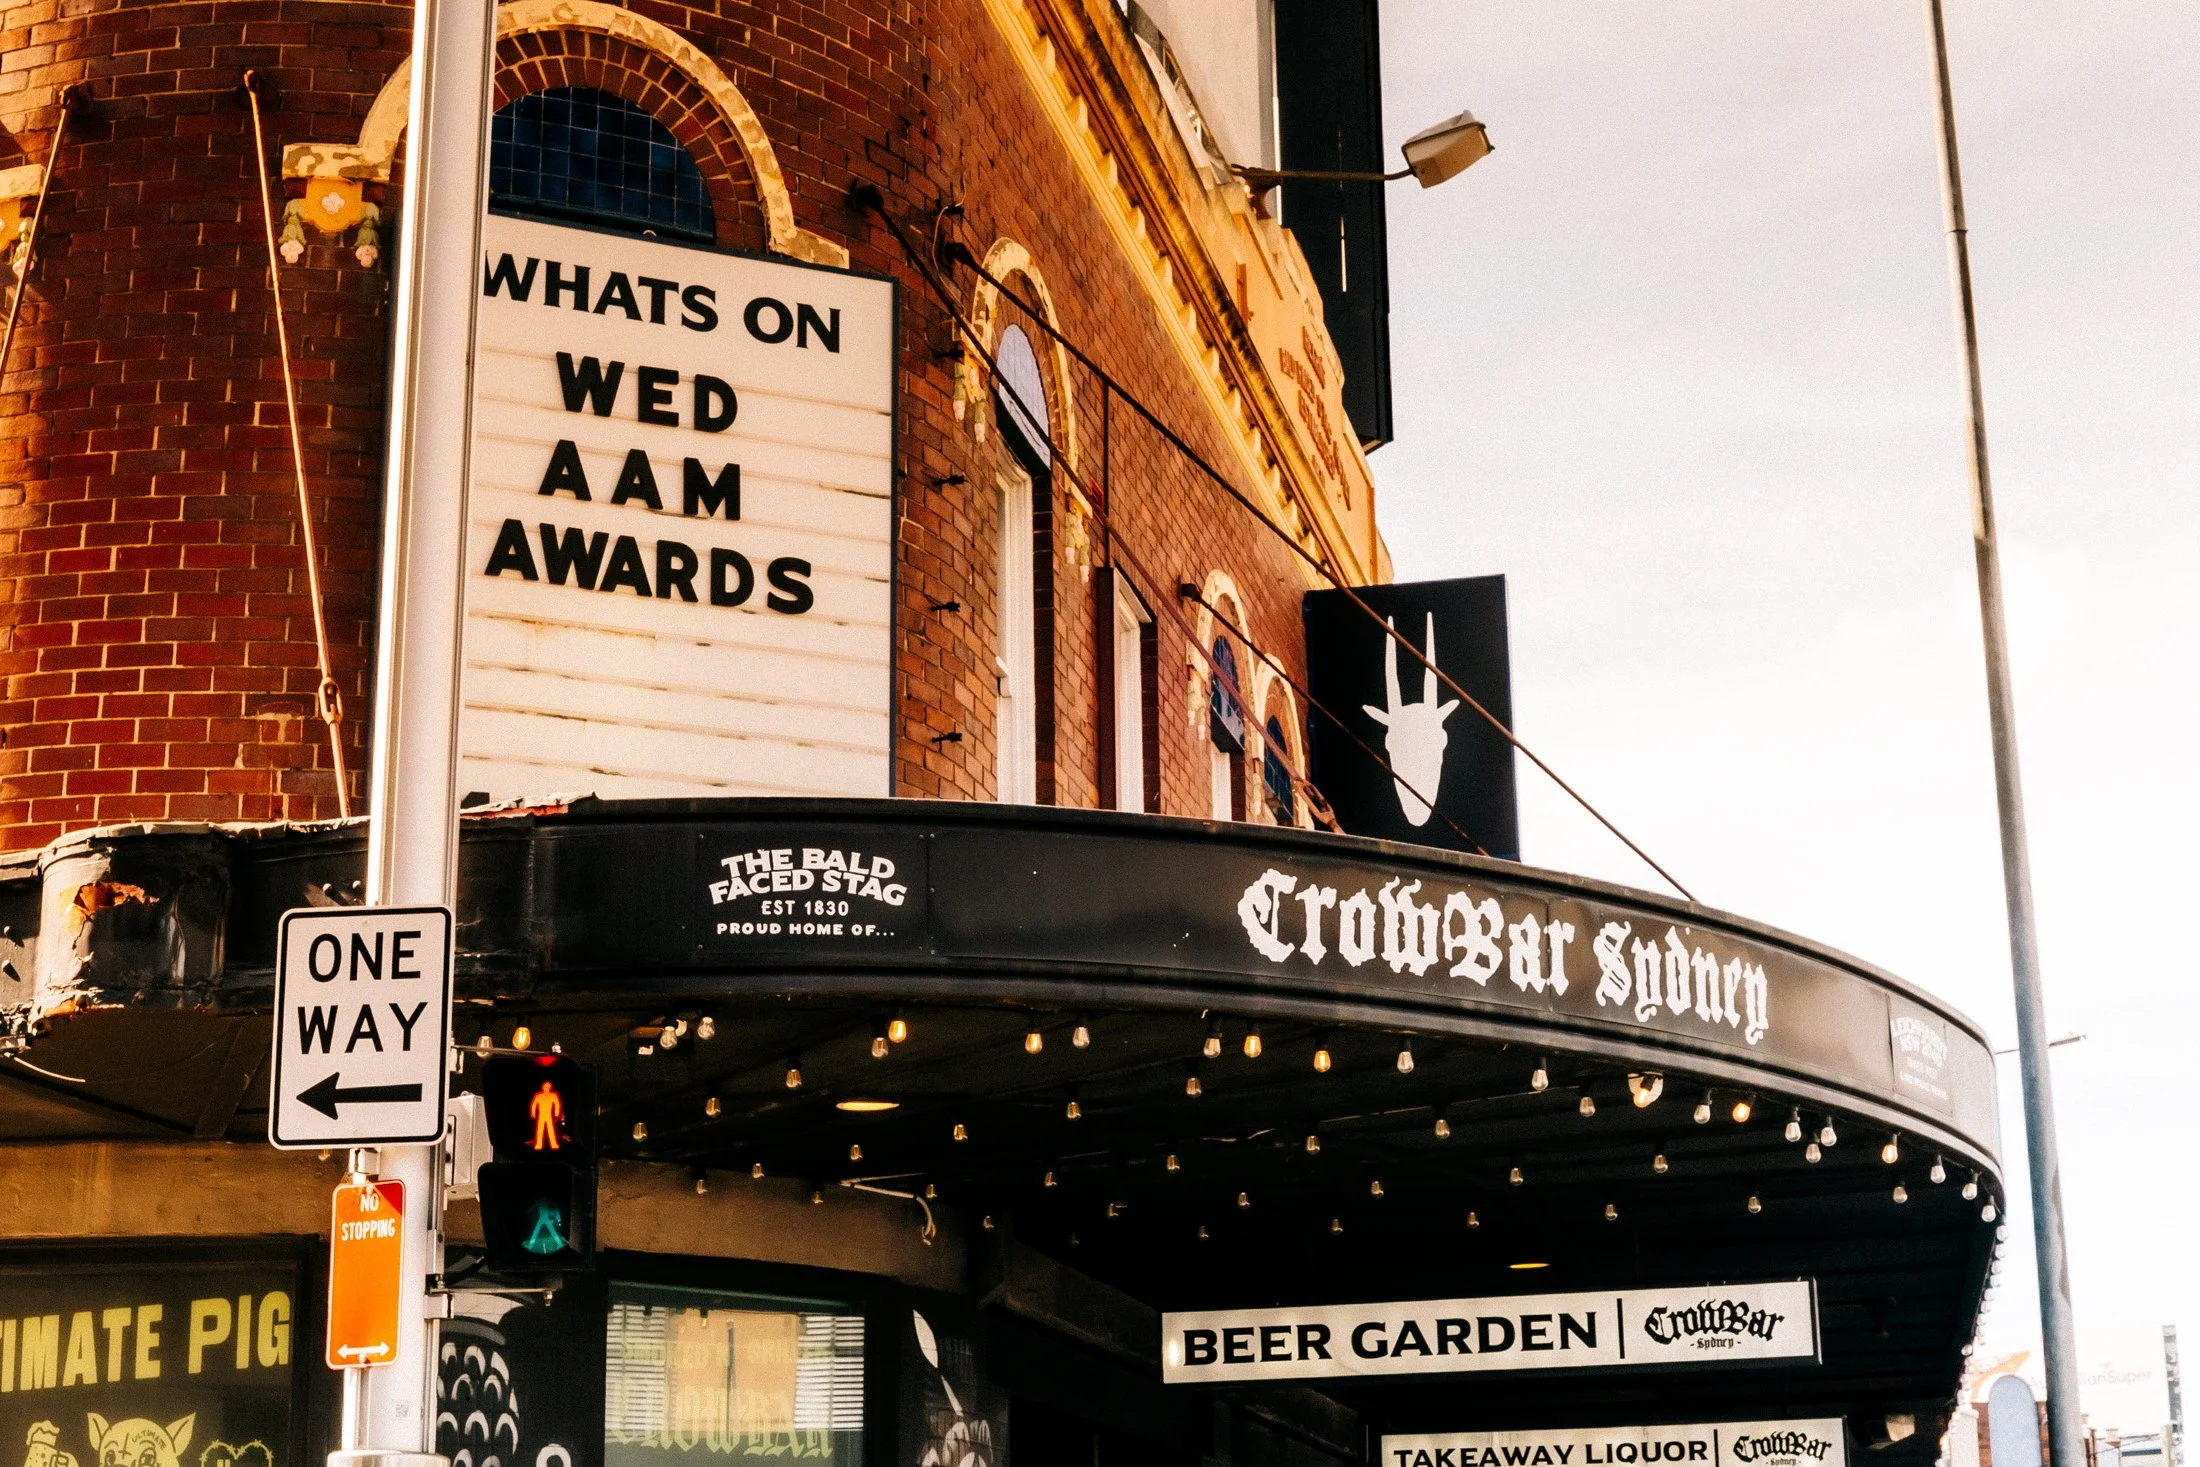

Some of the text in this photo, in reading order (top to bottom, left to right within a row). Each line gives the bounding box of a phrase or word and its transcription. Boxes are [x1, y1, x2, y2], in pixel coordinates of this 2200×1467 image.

[483, 250, 841, 353] WHATS ON
[556, 351, 738, 433] WED
[484, 518, 814, 615] AWARDS
[720, 847, 896, 879] THE BALD
[708, 869, 908, 906] FACED STAG
[761, 900, 849, 916] EST 1830
[716, 922, 782, 935] PROUD
[789, 923, 844, 936] HOME
[308, 930, 422, 983] ONE
[1593, 921, 1769, 1045] Sydney
[297, 1002, 429, 1055] WAY
[360, 1193, 380, 1213] NO
[341, 1218, 396, 1241] STOPPING
[0, 1290, 291, 1393] IMATE PIG
[1182, 1311, 1599, 1367] BEER GARDEN
[131, 1428, 167, 1451] ULTIMATE
[1394, 1440, 1708, 1467] TAKEAWAY LIQUOR
